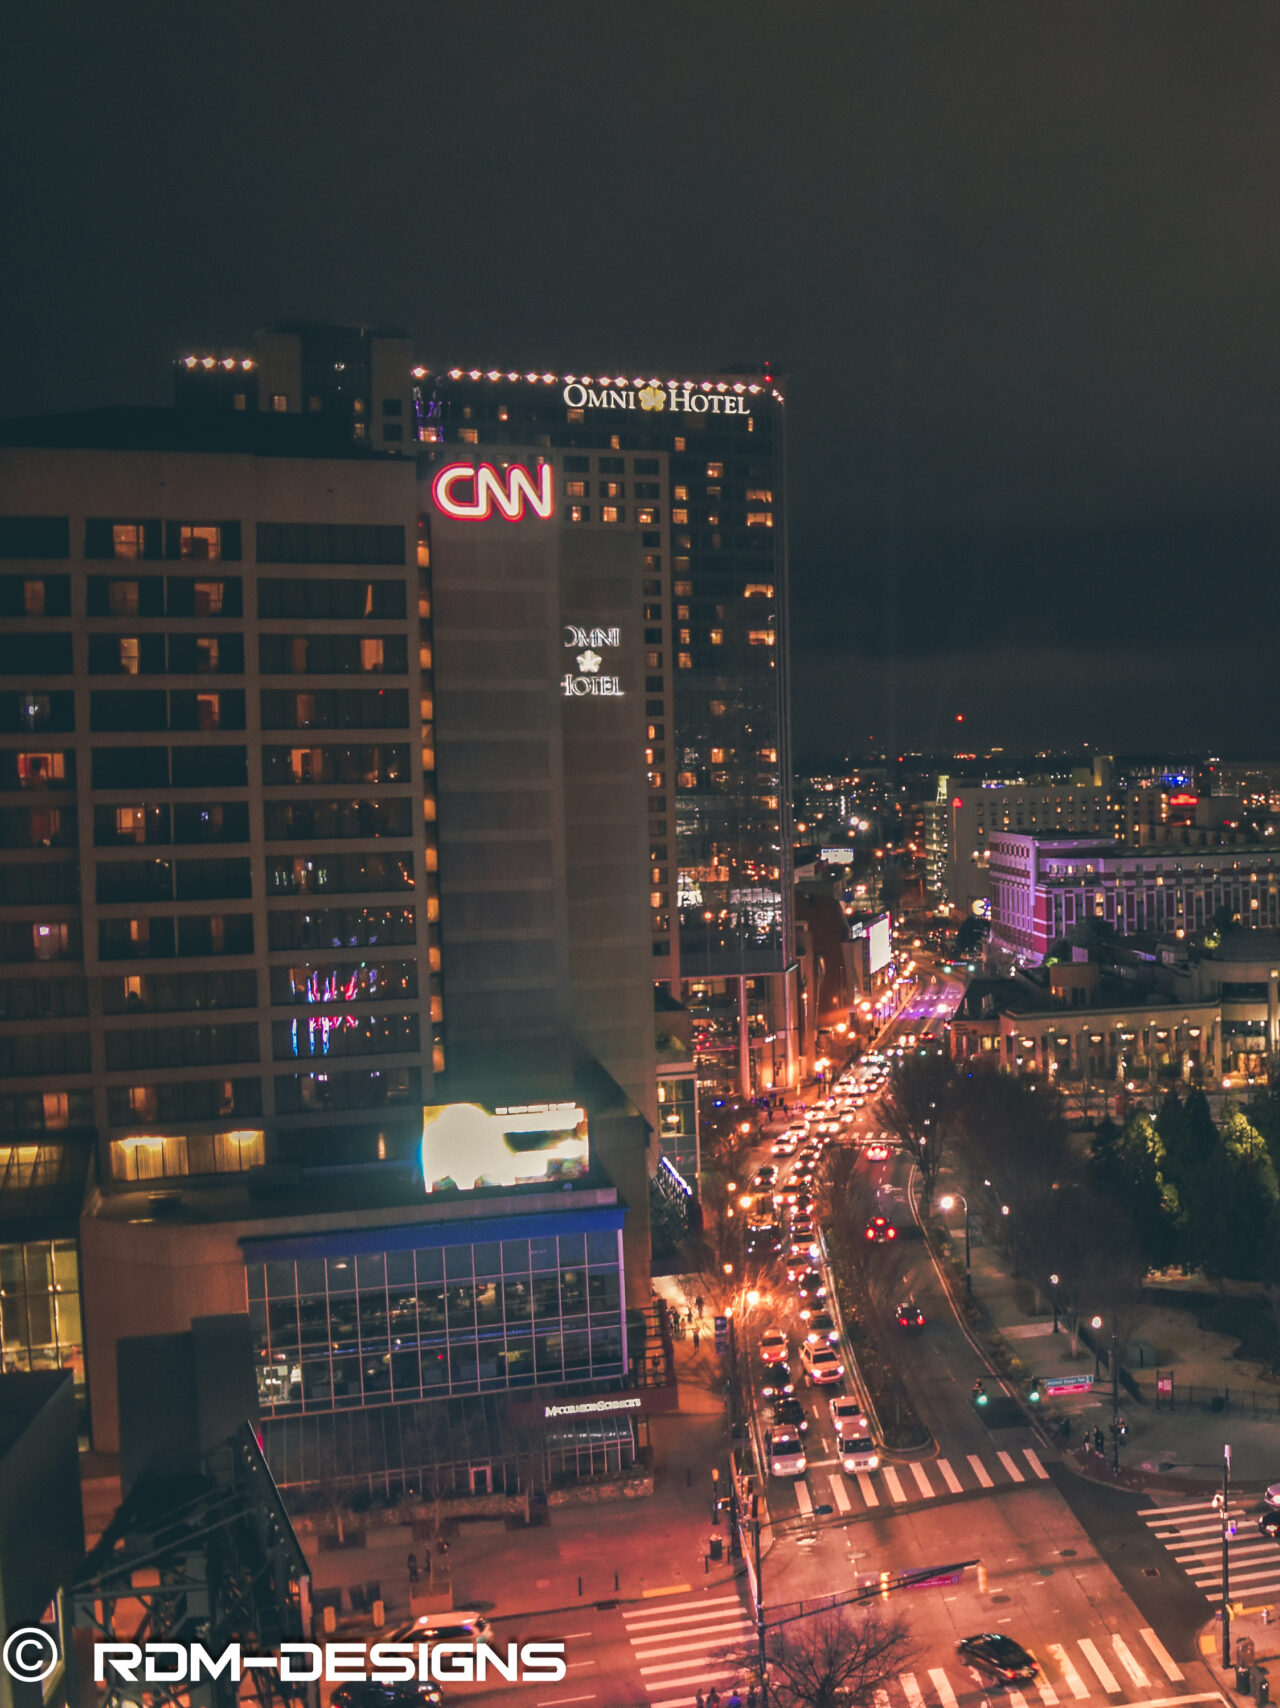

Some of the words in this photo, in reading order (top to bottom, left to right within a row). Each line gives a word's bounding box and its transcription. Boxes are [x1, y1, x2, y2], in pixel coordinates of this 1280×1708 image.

[563, 383, 636, 409] OMNI
[668, 388, 750, 414] HOTEL
[432, 462, 553, 522] CNN
